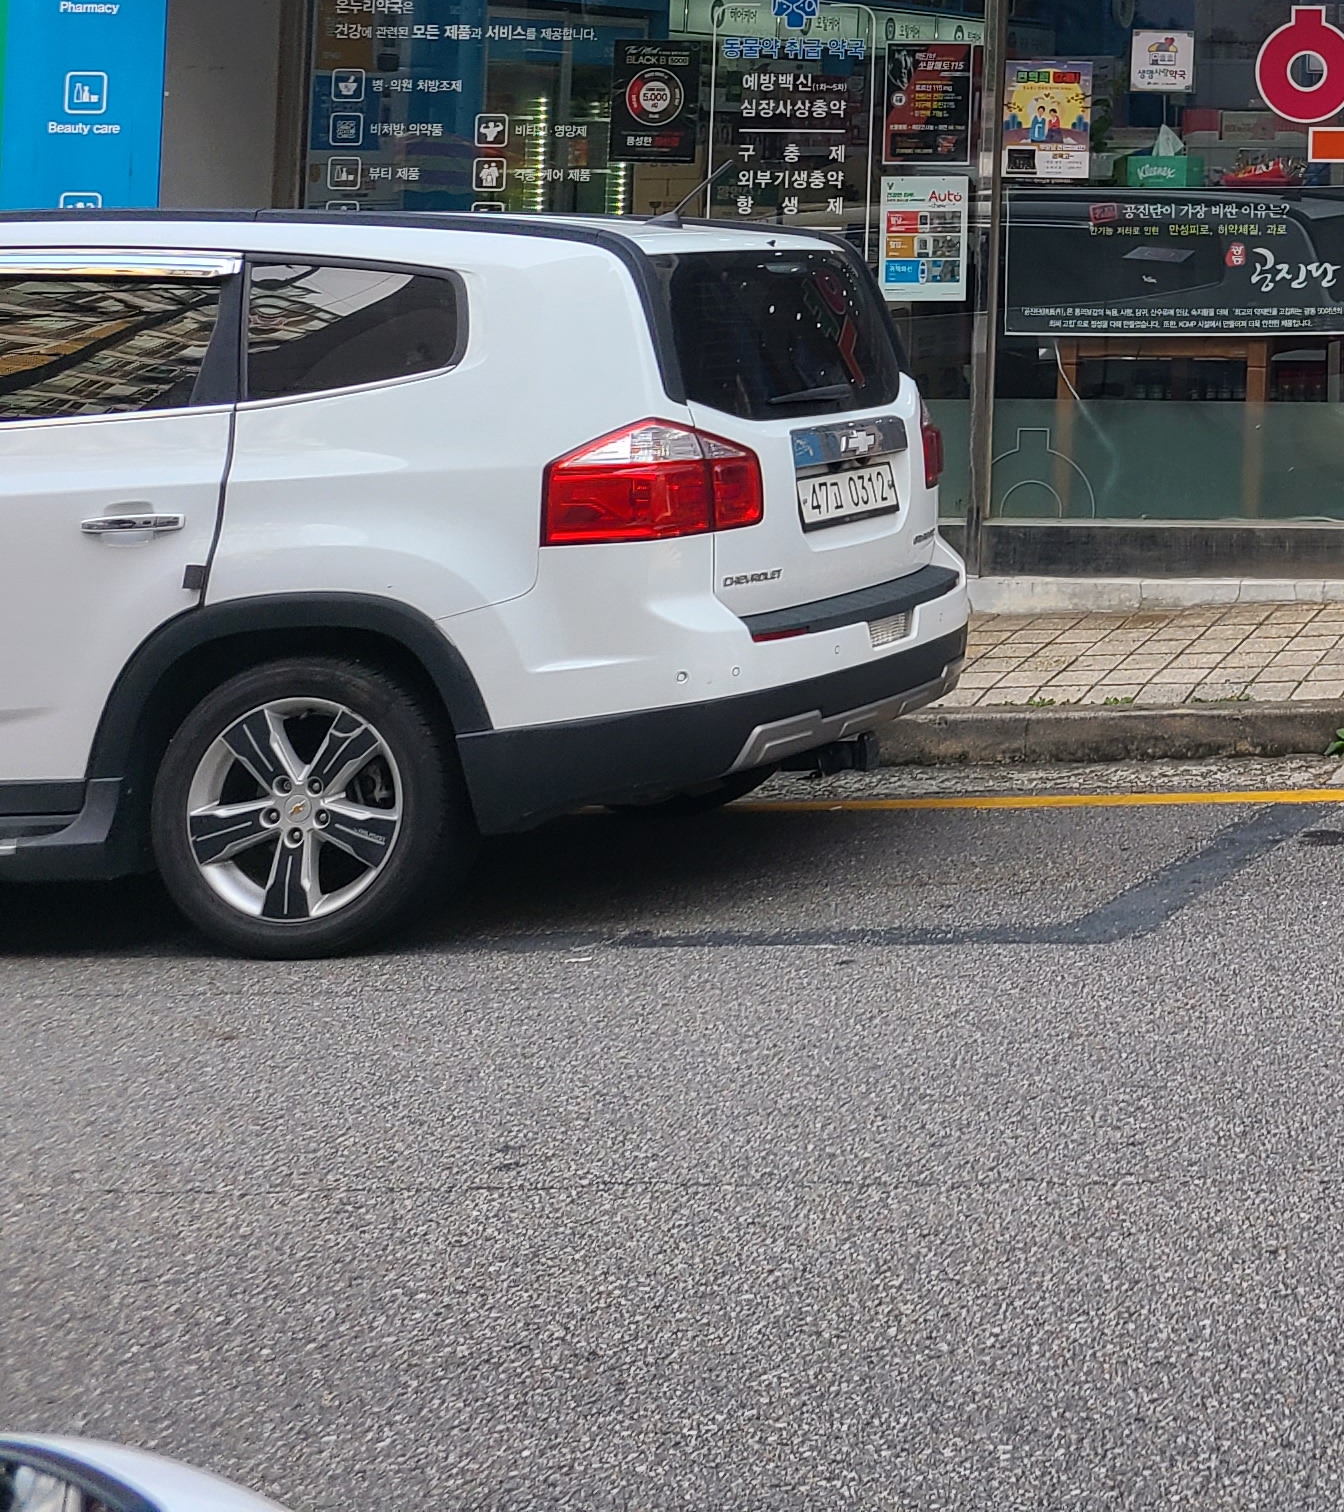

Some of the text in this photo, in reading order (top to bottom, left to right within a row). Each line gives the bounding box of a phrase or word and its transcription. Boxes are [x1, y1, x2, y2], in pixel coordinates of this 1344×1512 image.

[60, 1, 119, 15] Pharmacy
[335, 0, 413, 15] 온누리약국은
[334, 24, 372, 39] 건강에
[412, 24, 440, 40] 모든
[444, 25, 482, 40] 제품과
[485, 25, 536, 40] 서비스를
[722, 38, 866, 59] 동물약 취급 약국
[626, 56, 658, 65] BLACK
[417, 79, 463, 92] 처방조제
[740, 99, 847, 118] 심장사상충약
[48, 122, 120, 136] Beauty care
[409, 123, 443, 136] 의약품
[369, 167, 420, 181] 뷰티 제품
[567, 169, 592, 182] 제품
[737, 170, 844, 189] 외부기생충약
[1137, 164, 1177, 181] Kleenex
[929, 190, 962, 203] Auto
[1122, 203, 1176, 219] 공진단이
[1179, 203, 1208, 218] 가장
[1212, 204, 1239, 219] 비싼
[1241, 203, 1291, 219] 이유는?
[1169, 224, 1214, 236] 만성피로,
[1267, 224, 1288, 235] 과로
[1251, 247, 1342, 292] 공진단
[848, 471, 889, 507] 0312
